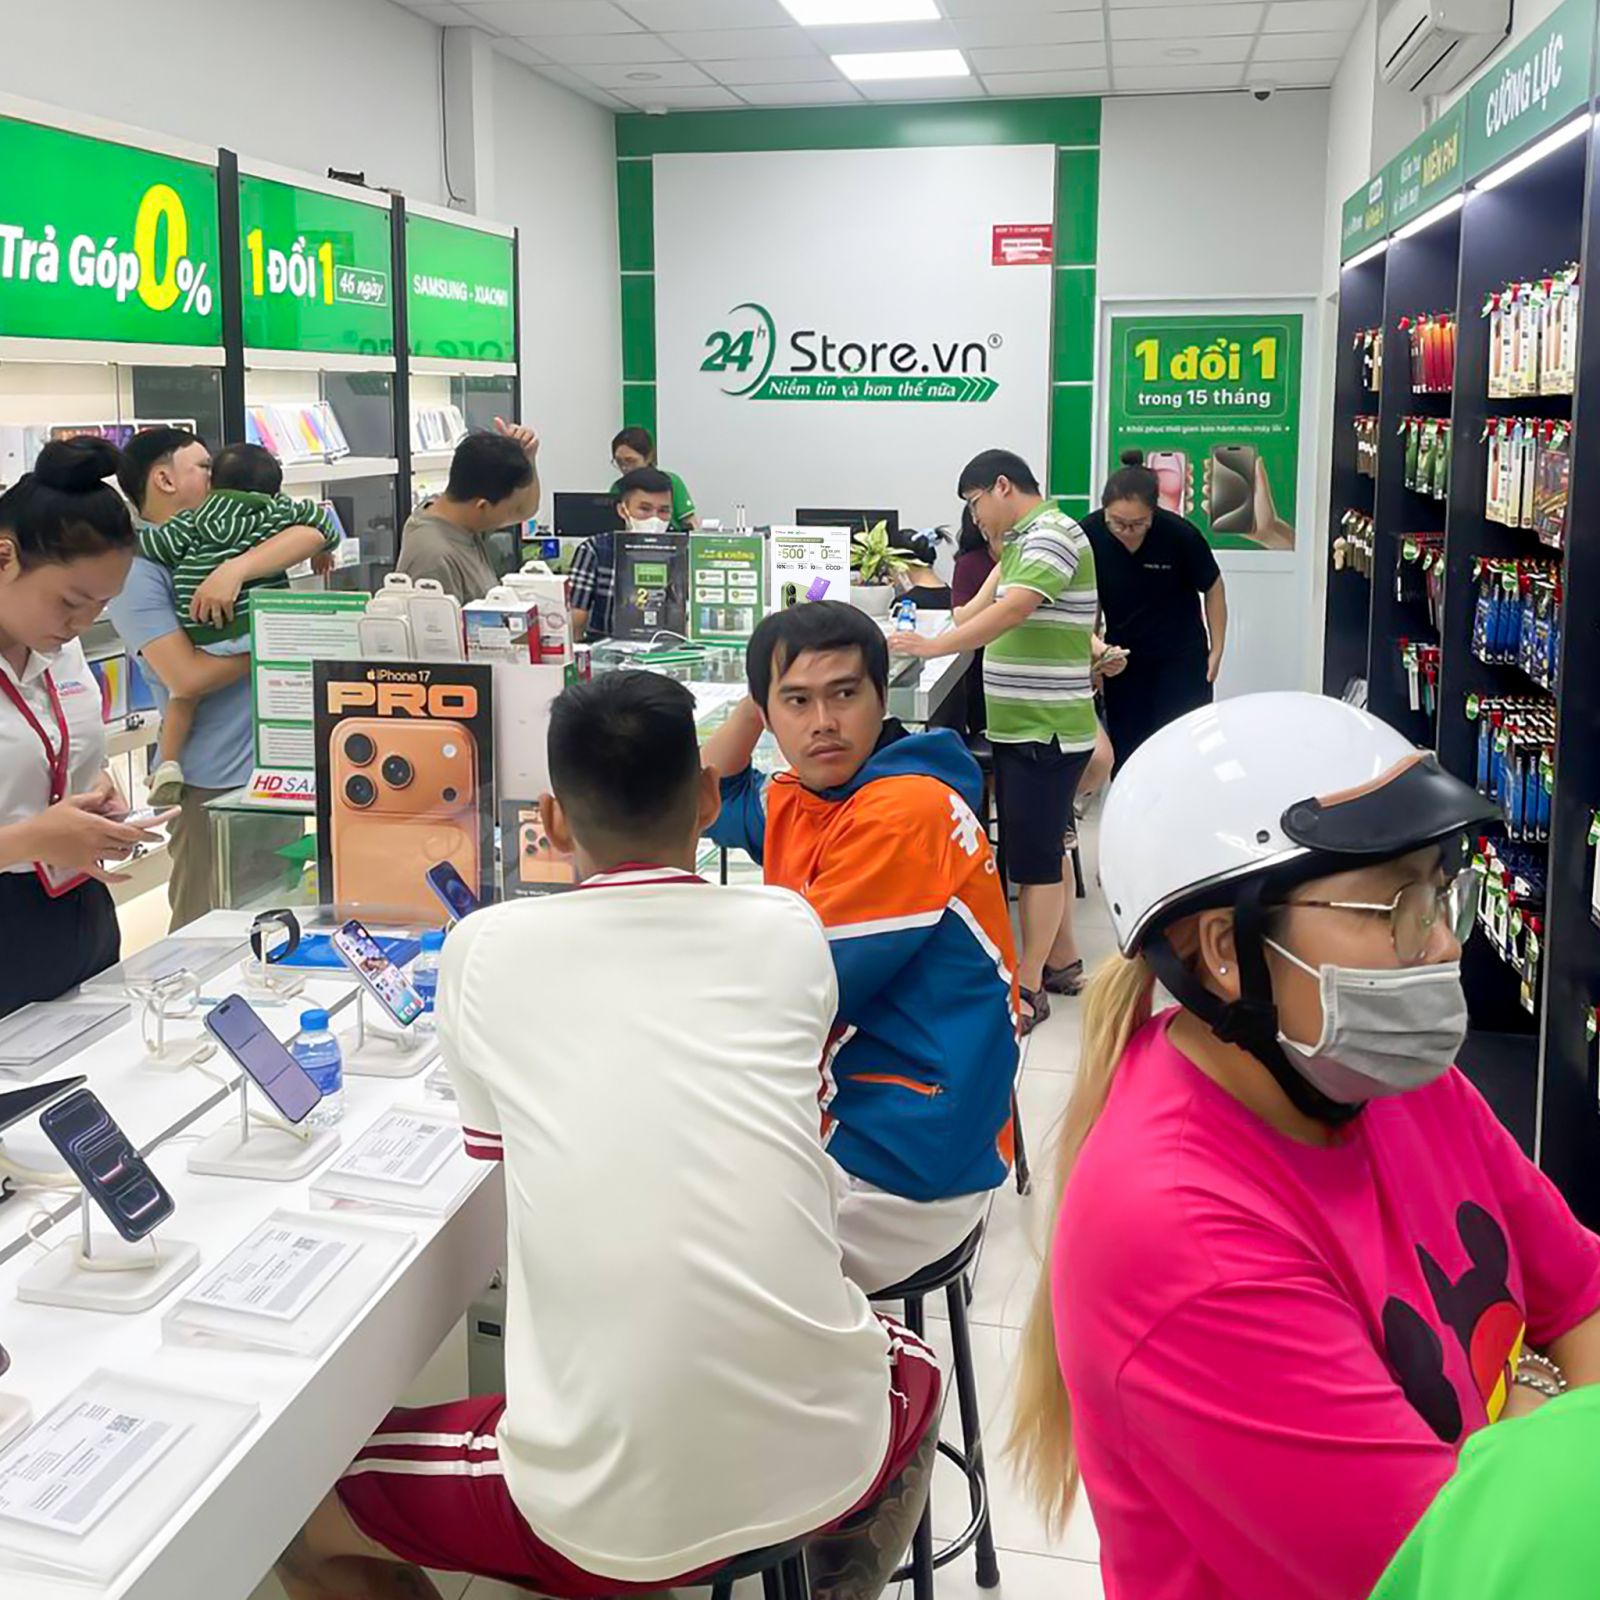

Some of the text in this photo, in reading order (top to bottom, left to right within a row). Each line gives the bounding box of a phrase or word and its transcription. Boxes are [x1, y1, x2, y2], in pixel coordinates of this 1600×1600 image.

[1486, 32, 1563, 137] CƯỜNG LỰC
[0, 223, 59, 284] Trả
[69, 234, 139, 302] Góp
[247, 228, 334, 305] 1 ĐỔI 1
[340, 272, 384, 302] 46 ngày
[413, 274, 468, 301] SAMSUNG
[474, 284, 508, 307] XIAOMI
[1135, 337, 1277, 381] 1 đổi 1
[769, 378, 956, 397] Niềm tin và hơn thế nữa
[1138, 387, 1271, 408] trong 15 tháng
[376, 669, 431, 682] iPhone 17
[327, 681, 478, 718] PRO
[253, 775, 283, 791] HD
